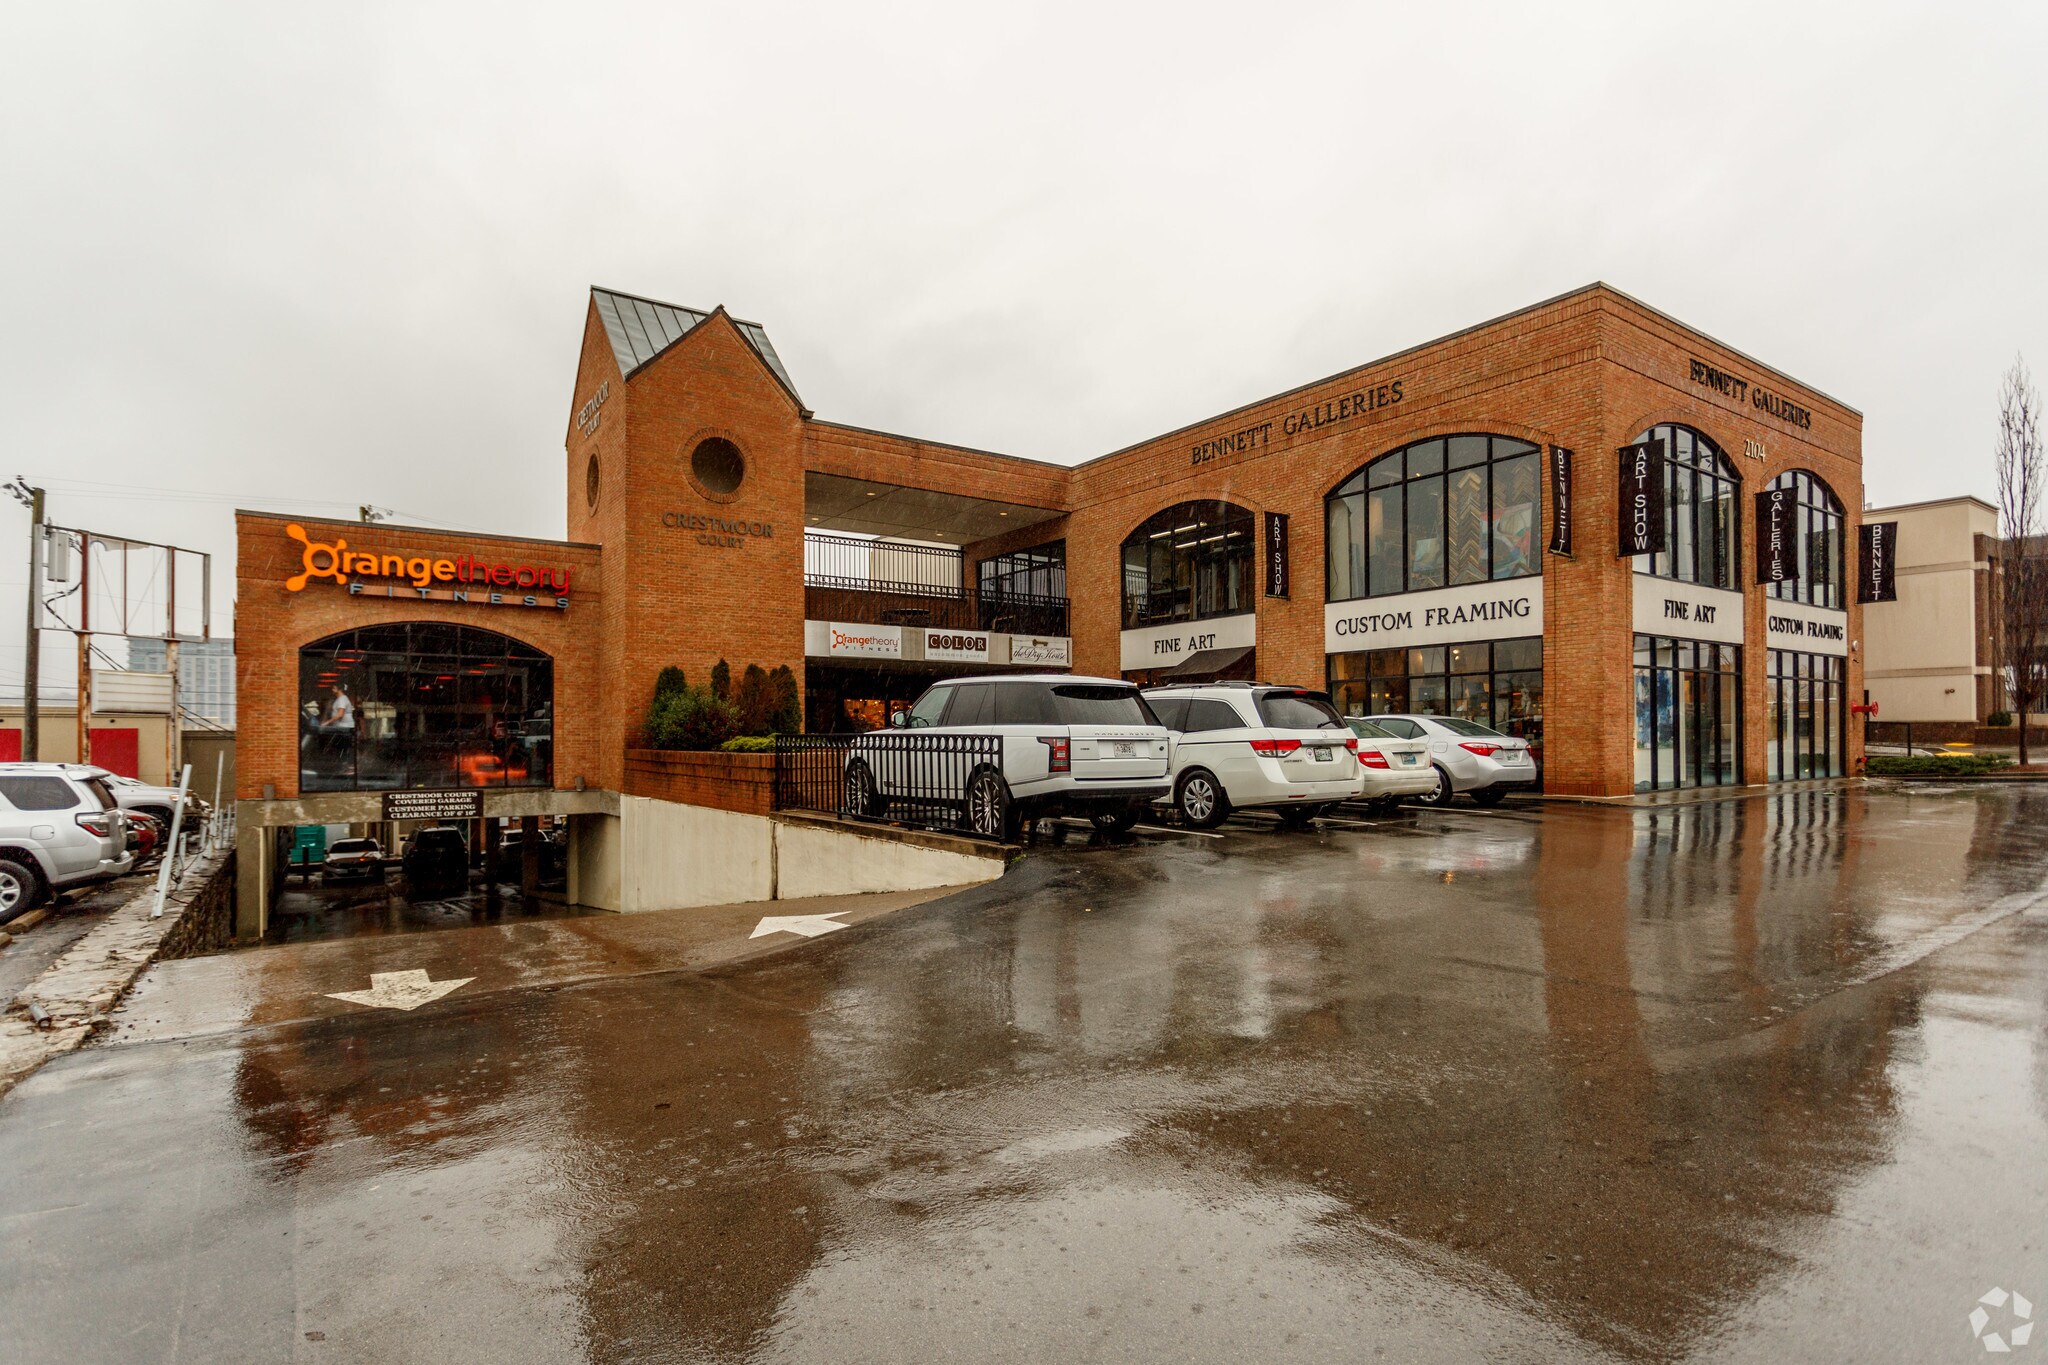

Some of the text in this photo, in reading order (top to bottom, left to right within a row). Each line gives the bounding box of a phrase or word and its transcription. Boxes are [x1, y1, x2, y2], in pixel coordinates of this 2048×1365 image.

[1690, 358, 1811, 430] BENNETT GALLERIES
[1191, 380, 1403, 465] BENNETT GALLERIES
[1744, 438, 1766, 463] 2104
[1557, 448, 1567, 554] BENNETT
[1634, 447, 1648, 551] ART SHOW
[661, 511, 773, 538] CRESTMOOR
[1770, 491, 1783, 581] GALLERIES
[695, 533, 744, 549] COURT
[1273, 516, 1283, 596] ART SHOW
[1871, 525, 1882, 601] BENNETT
[350, 583, 570, 610] FITNESS
[1335, 597, 1531, 637] CUSTOM FRAMING
[1664, 598, 1716, 624] FINE ART
[1769, 615, 1843, 641] CUSTOM FRAMING
[929, 635, 986, 650] COLOR
[1154, 633, 1216, 654] FINE ART
[388, 792, 443, 800] CRESTMOOR
[388, 804, 476, 813] CUSTOMER PARKING
[390, 811, 443, 819] CLEARANCE
